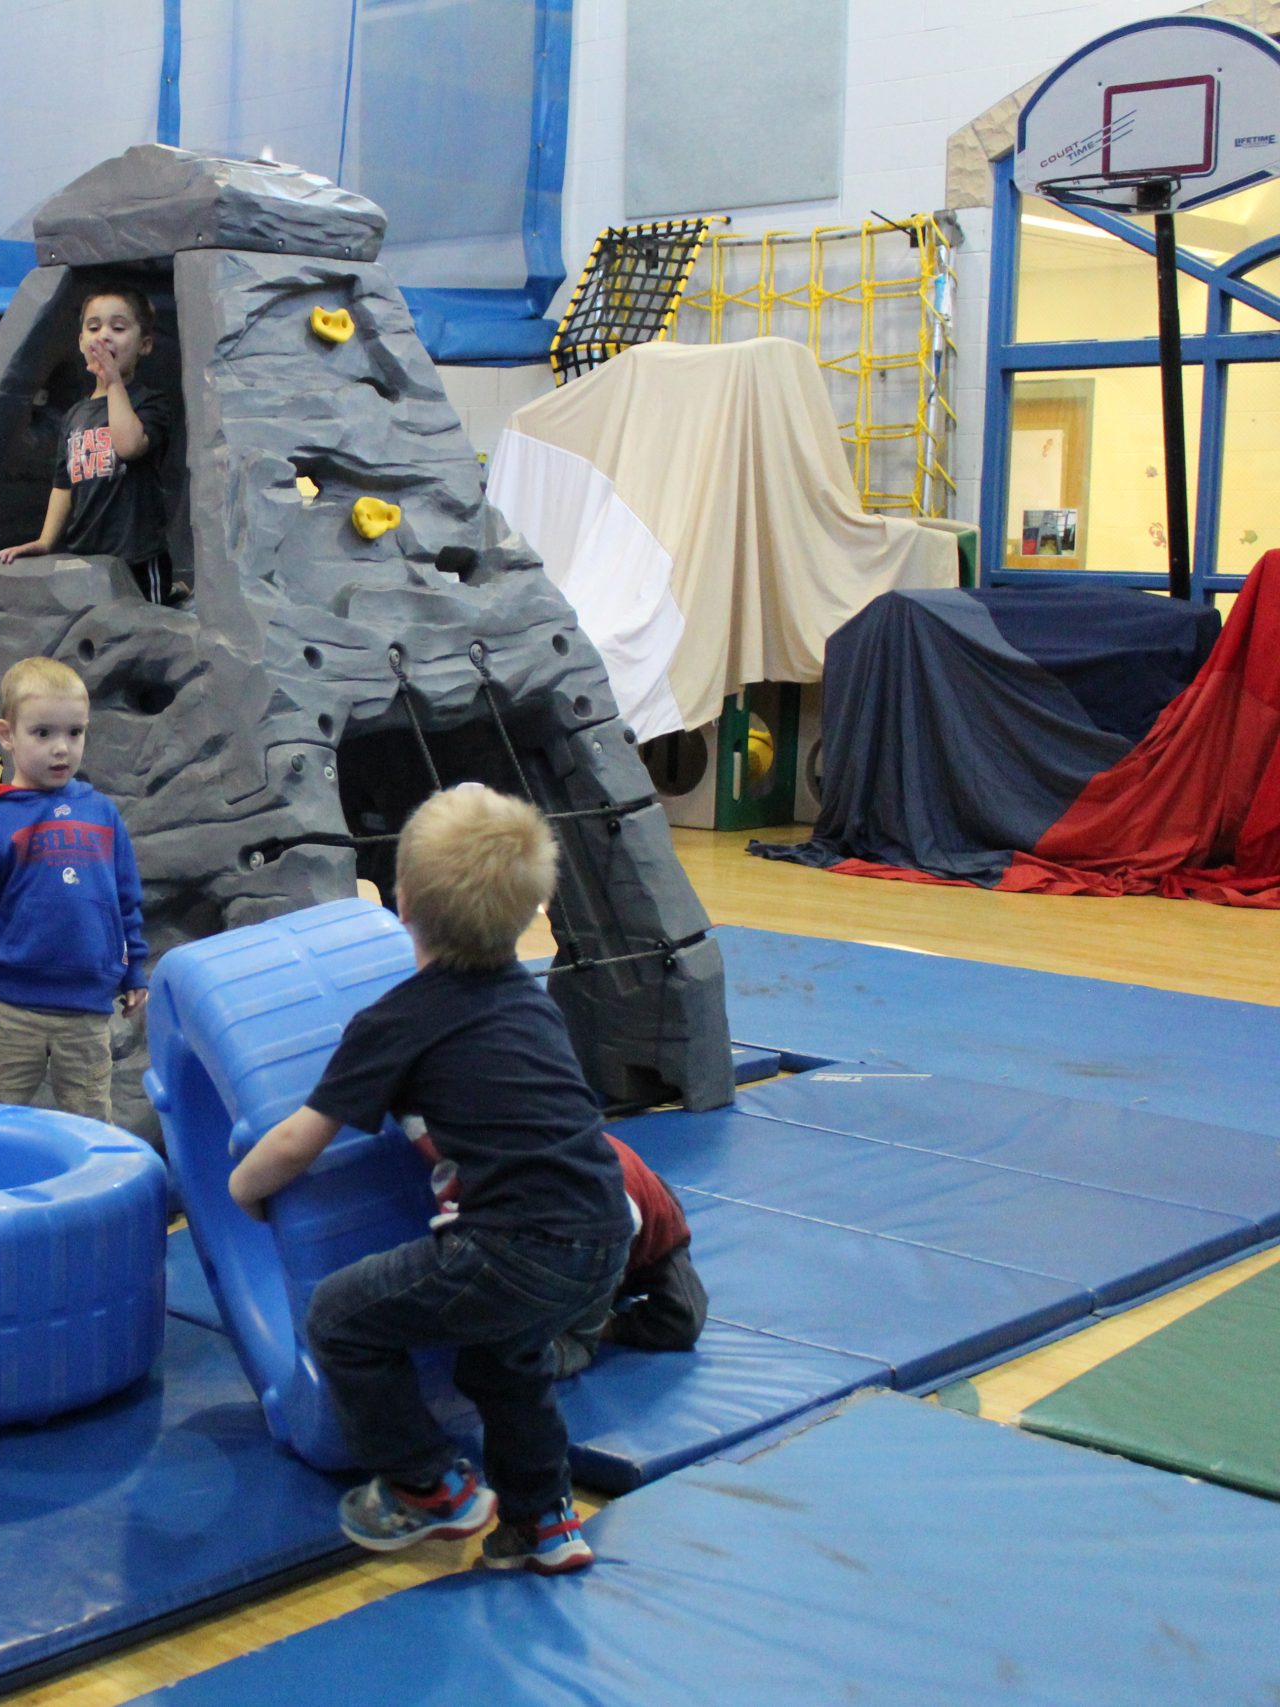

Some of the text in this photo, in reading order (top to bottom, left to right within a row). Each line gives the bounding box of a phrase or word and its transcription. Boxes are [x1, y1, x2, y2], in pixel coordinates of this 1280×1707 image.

[1066, 141, 1096, 161] TIME
[1234, 134, 1276, 148] LIFETIME
[1040, 141, 1079, 168] COURT
